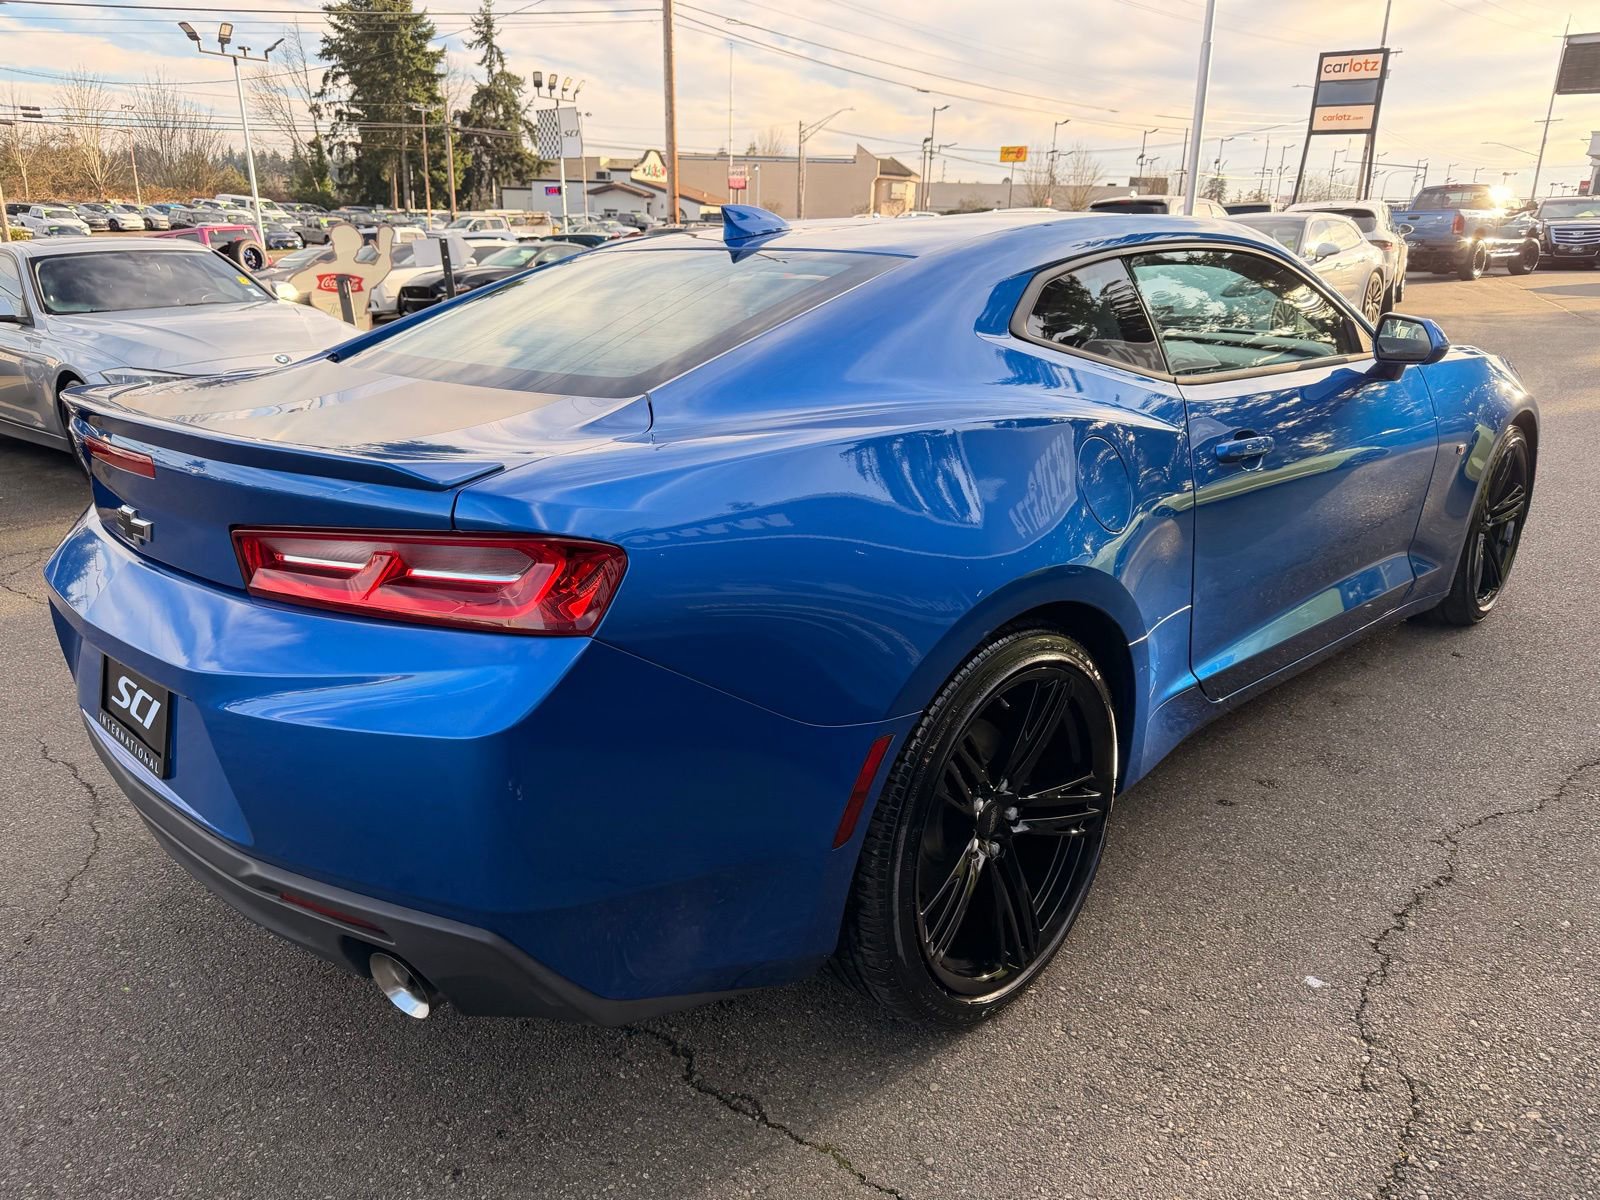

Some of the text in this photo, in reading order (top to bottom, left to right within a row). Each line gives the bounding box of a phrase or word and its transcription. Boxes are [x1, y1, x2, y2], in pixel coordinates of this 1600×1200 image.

[1323, 58, 1379, 74] carlotz
[564, 129, 580, 137] SCI
[111, 675, 161, 730] SCI
[99, 712, 159, 774] INTERNATIONAL
